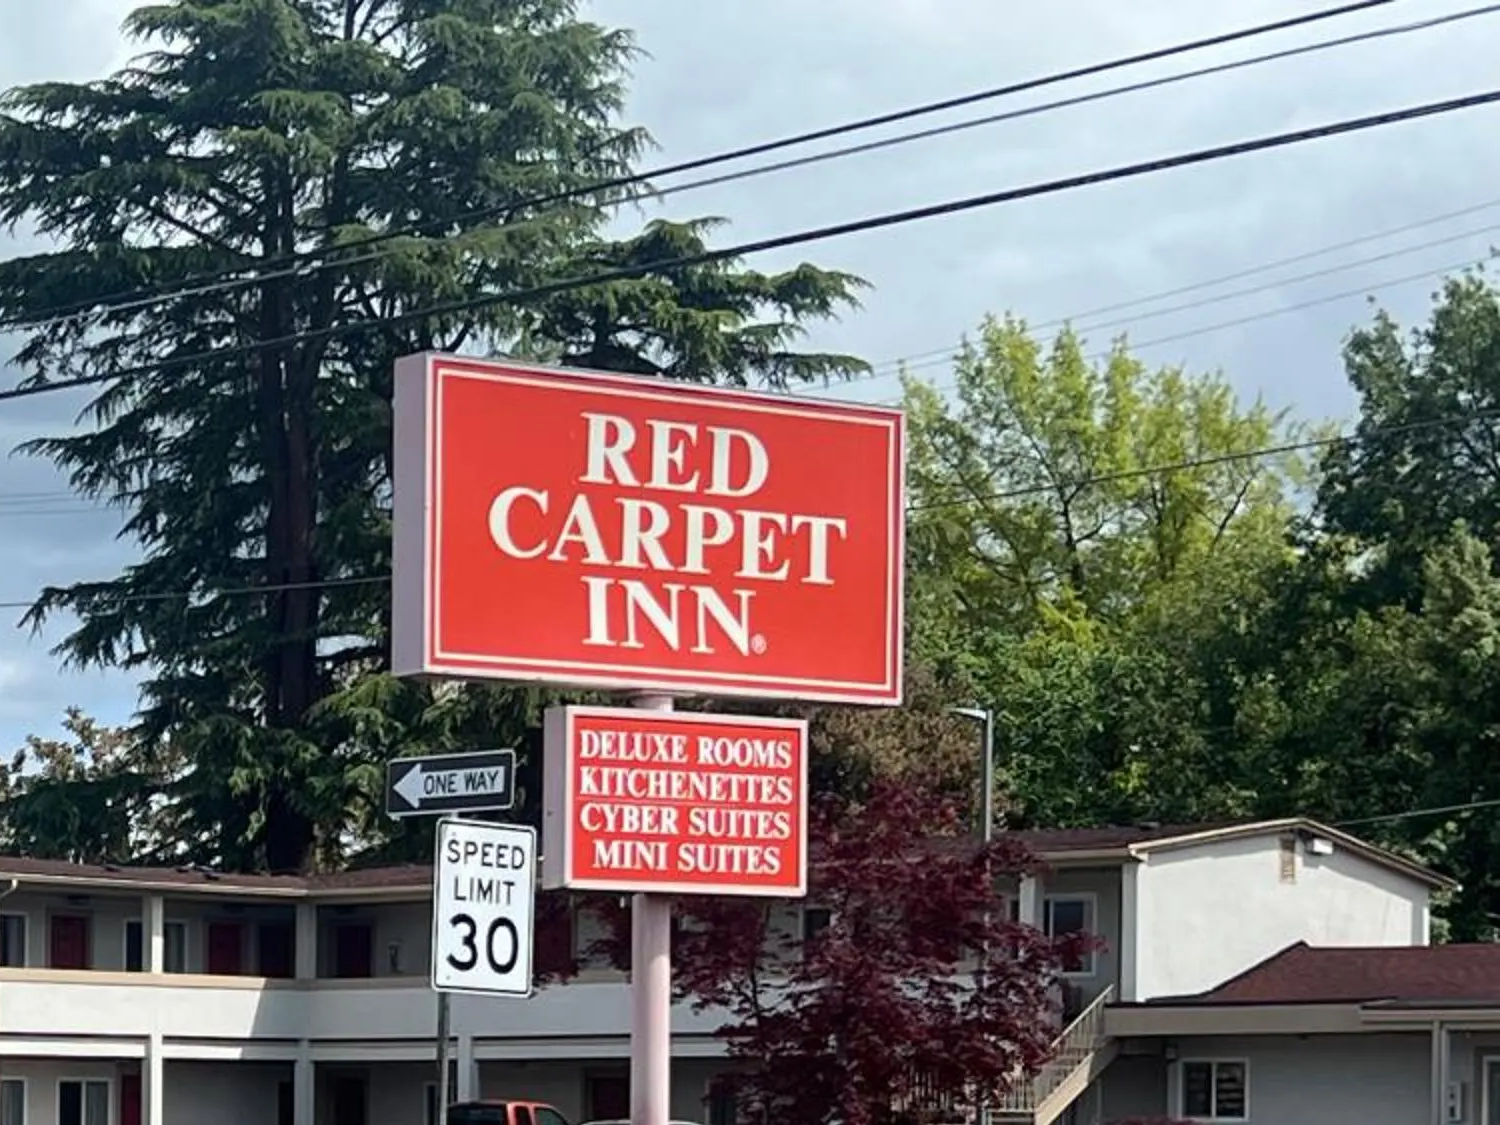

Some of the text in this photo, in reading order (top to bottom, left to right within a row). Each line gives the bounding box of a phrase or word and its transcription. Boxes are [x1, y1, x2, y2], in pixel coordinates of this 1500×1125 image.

[578, 411, 769, 498] RED
[488, 486, 848, 585] CARPET
[579, 729, 793, 769] DELUXE ROOMS
[423, 769, 500, 796] ONE WAY
[579, 765, 793, 805] KITCHENETTES
[579, 802, 791, 840] CYBER SUITES
[447, 838, 526, 871] SPEED
[592, 839, 781, 875] MINI SUITES
[453, 875, 516, 906] LIMIT
[446, 912, 519, 975] 30
